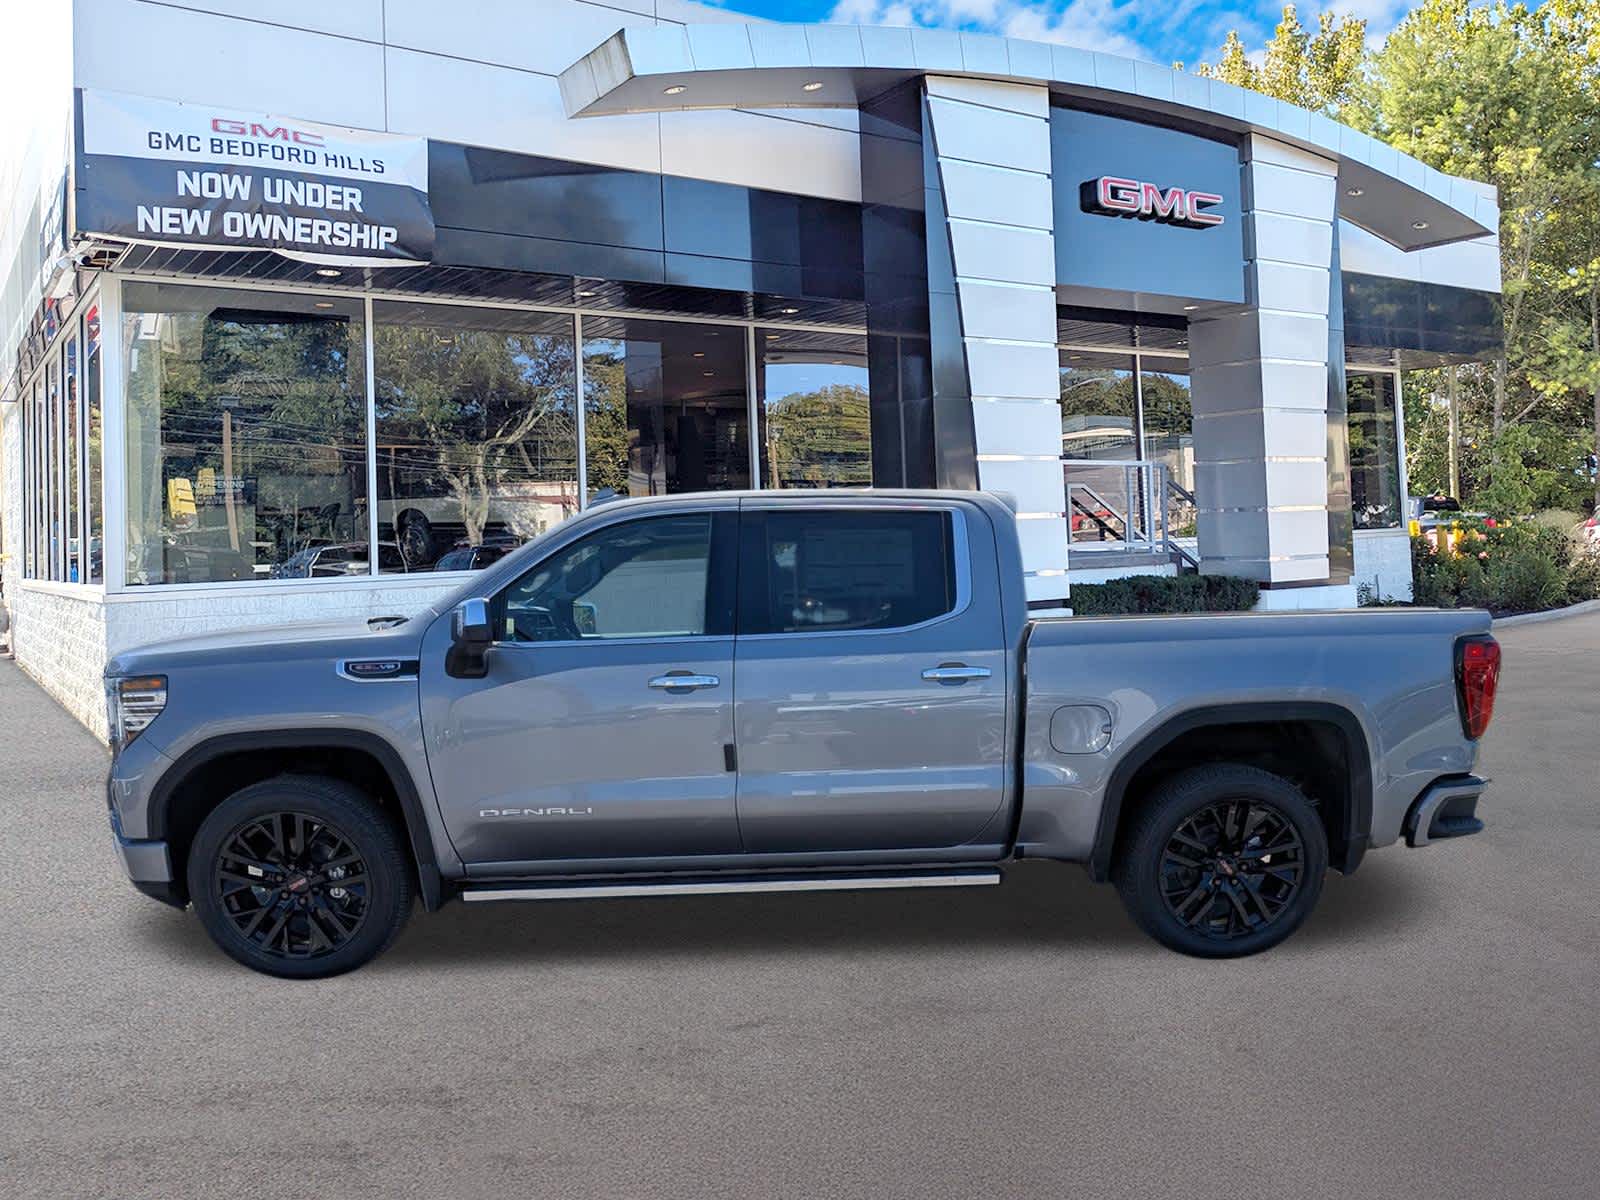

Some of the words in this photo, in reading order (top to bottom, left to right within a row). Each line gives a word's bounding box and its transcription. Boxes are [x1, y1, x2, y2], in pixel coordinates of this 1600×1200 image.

[147, 131, 201, 152] GMC
[210, 137, 317, 165] BEDFORD
[324, 153, 386, 174] HILLS
[211, 118, 325, 148] GMC
[177, 170, 252, 201] NOW
[263, 177, 363, 213] UNDER
[1096, 175, 1225, 225] GMC
[137, 205, 211, 236] NEW
[223, 211, 398, 250] OWNERSHIP
[480, 807, 593, 817] DENALI
